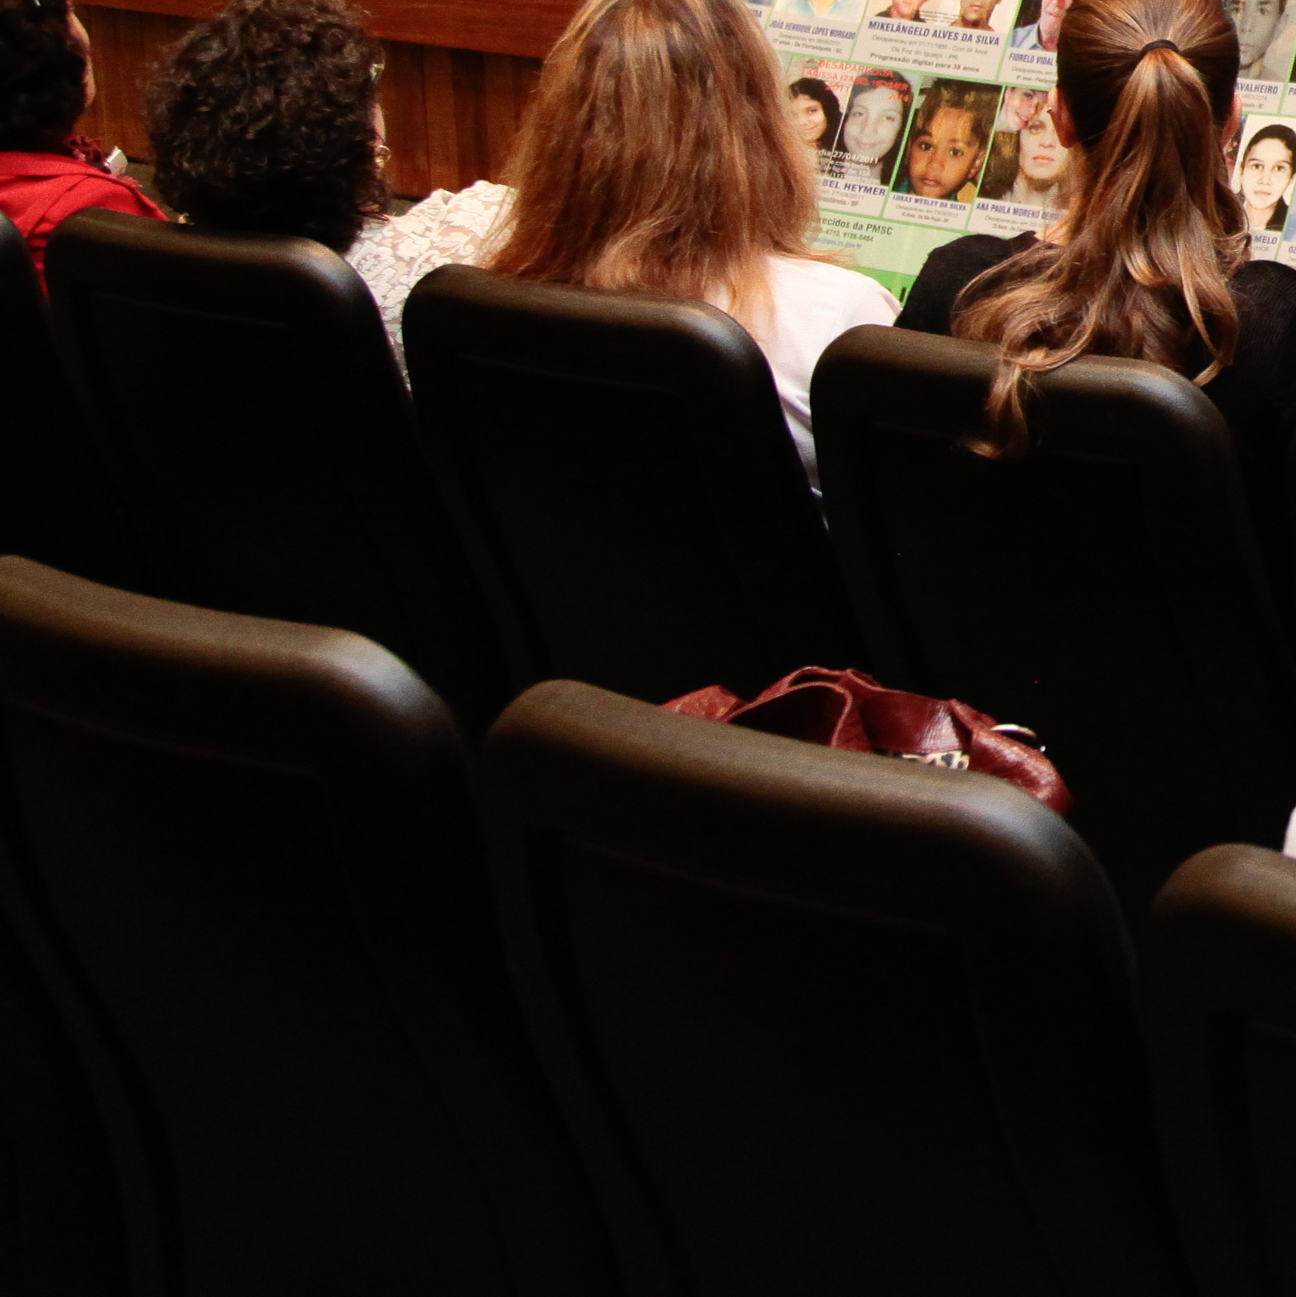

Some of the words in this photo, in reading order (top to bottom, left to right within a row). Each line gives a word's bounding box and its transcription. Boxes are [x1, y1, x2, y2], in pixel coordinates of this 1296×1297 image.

[867, 20, 930, 38] MIKELÂNGELO
[931, 29, 959, 41] ALVES
[961, 33, 973, 43] DA
[974, 34, 1000, 46] SILVA
[1253, 235, 1278, 245] MELO
